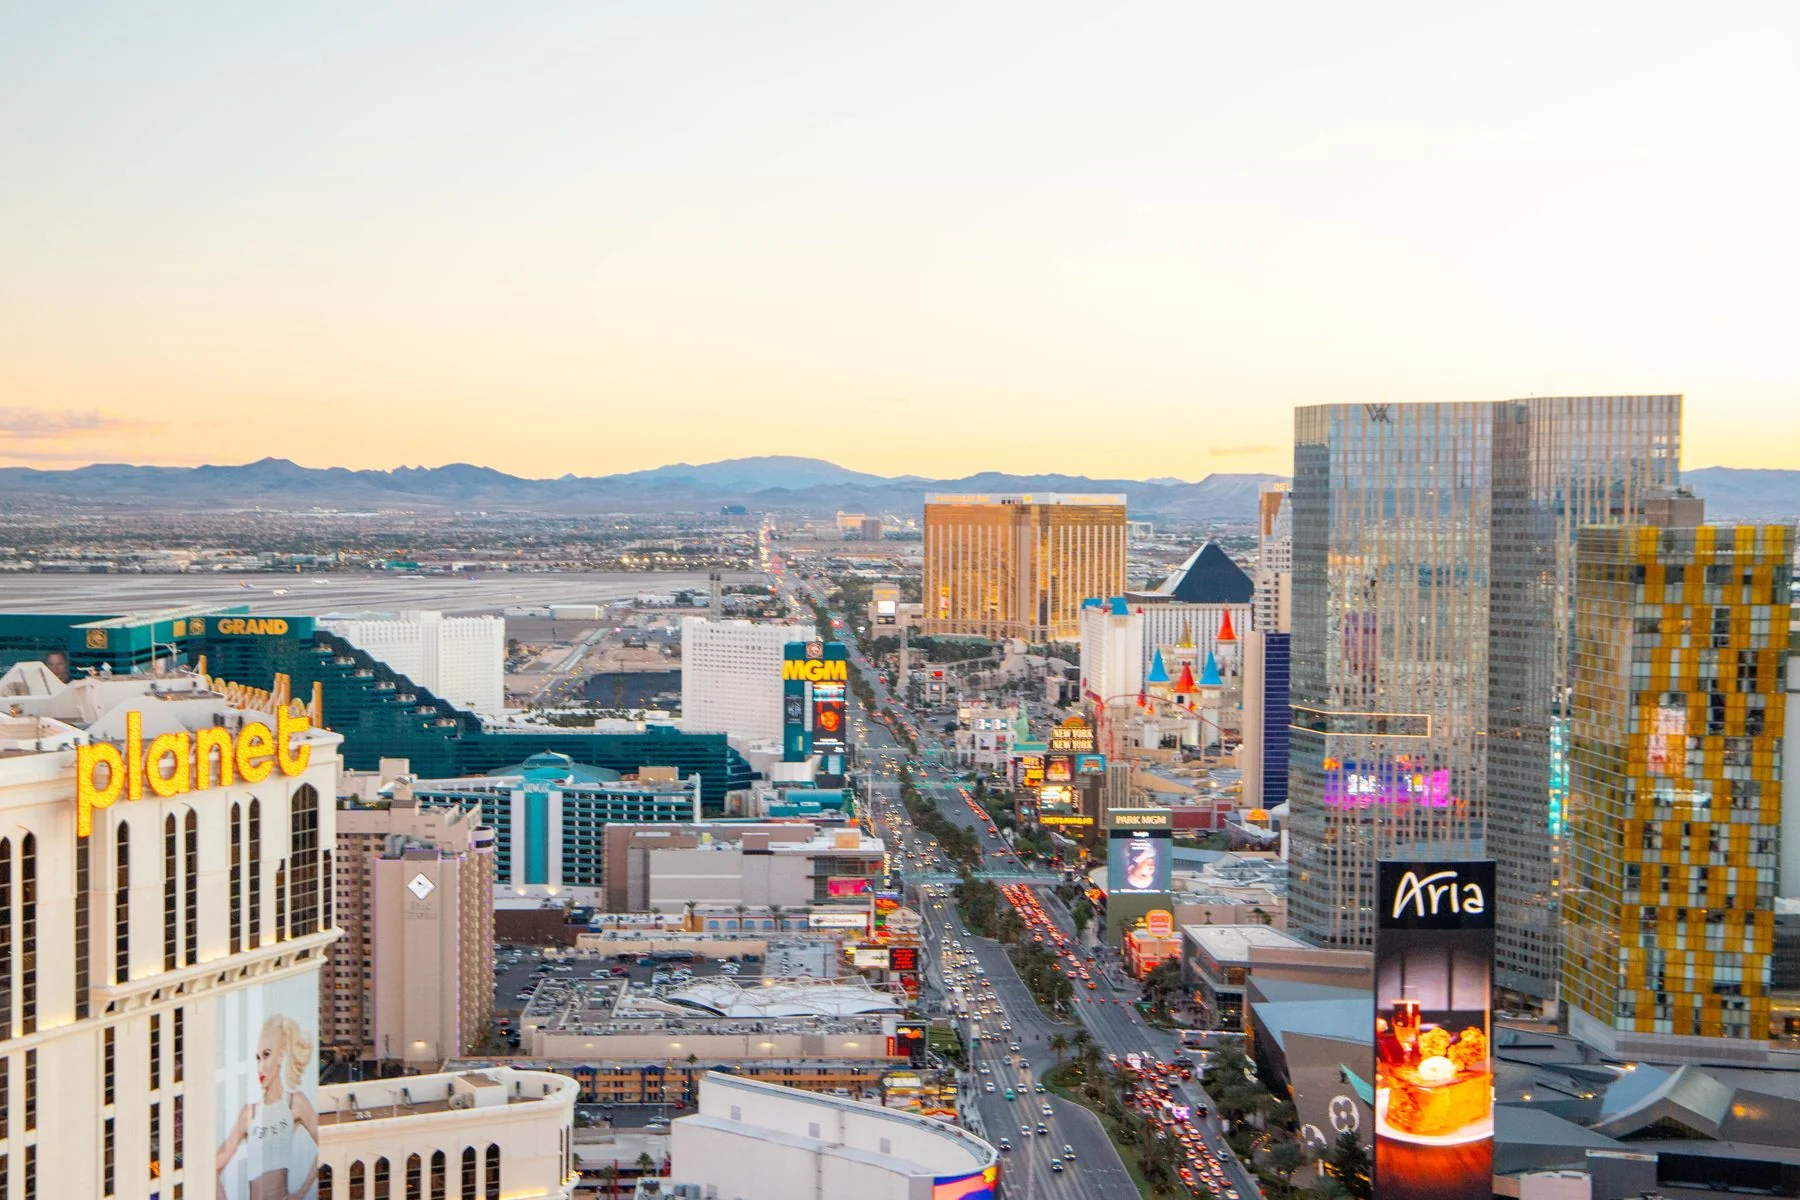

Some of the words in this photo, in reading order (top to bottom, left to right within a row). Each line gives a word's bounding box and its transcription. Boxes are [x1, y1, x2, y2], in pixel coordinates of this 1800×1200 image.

[218, 618, 289, 635] GRAND
[782, 660, 848, 681] MGM
[76, 705, 312, 837] planet
[1115, 815, 1141, 824] PARK
[1142, 815, 1167, 824] MGM
[1392, 870, 1485, 919] Aria
